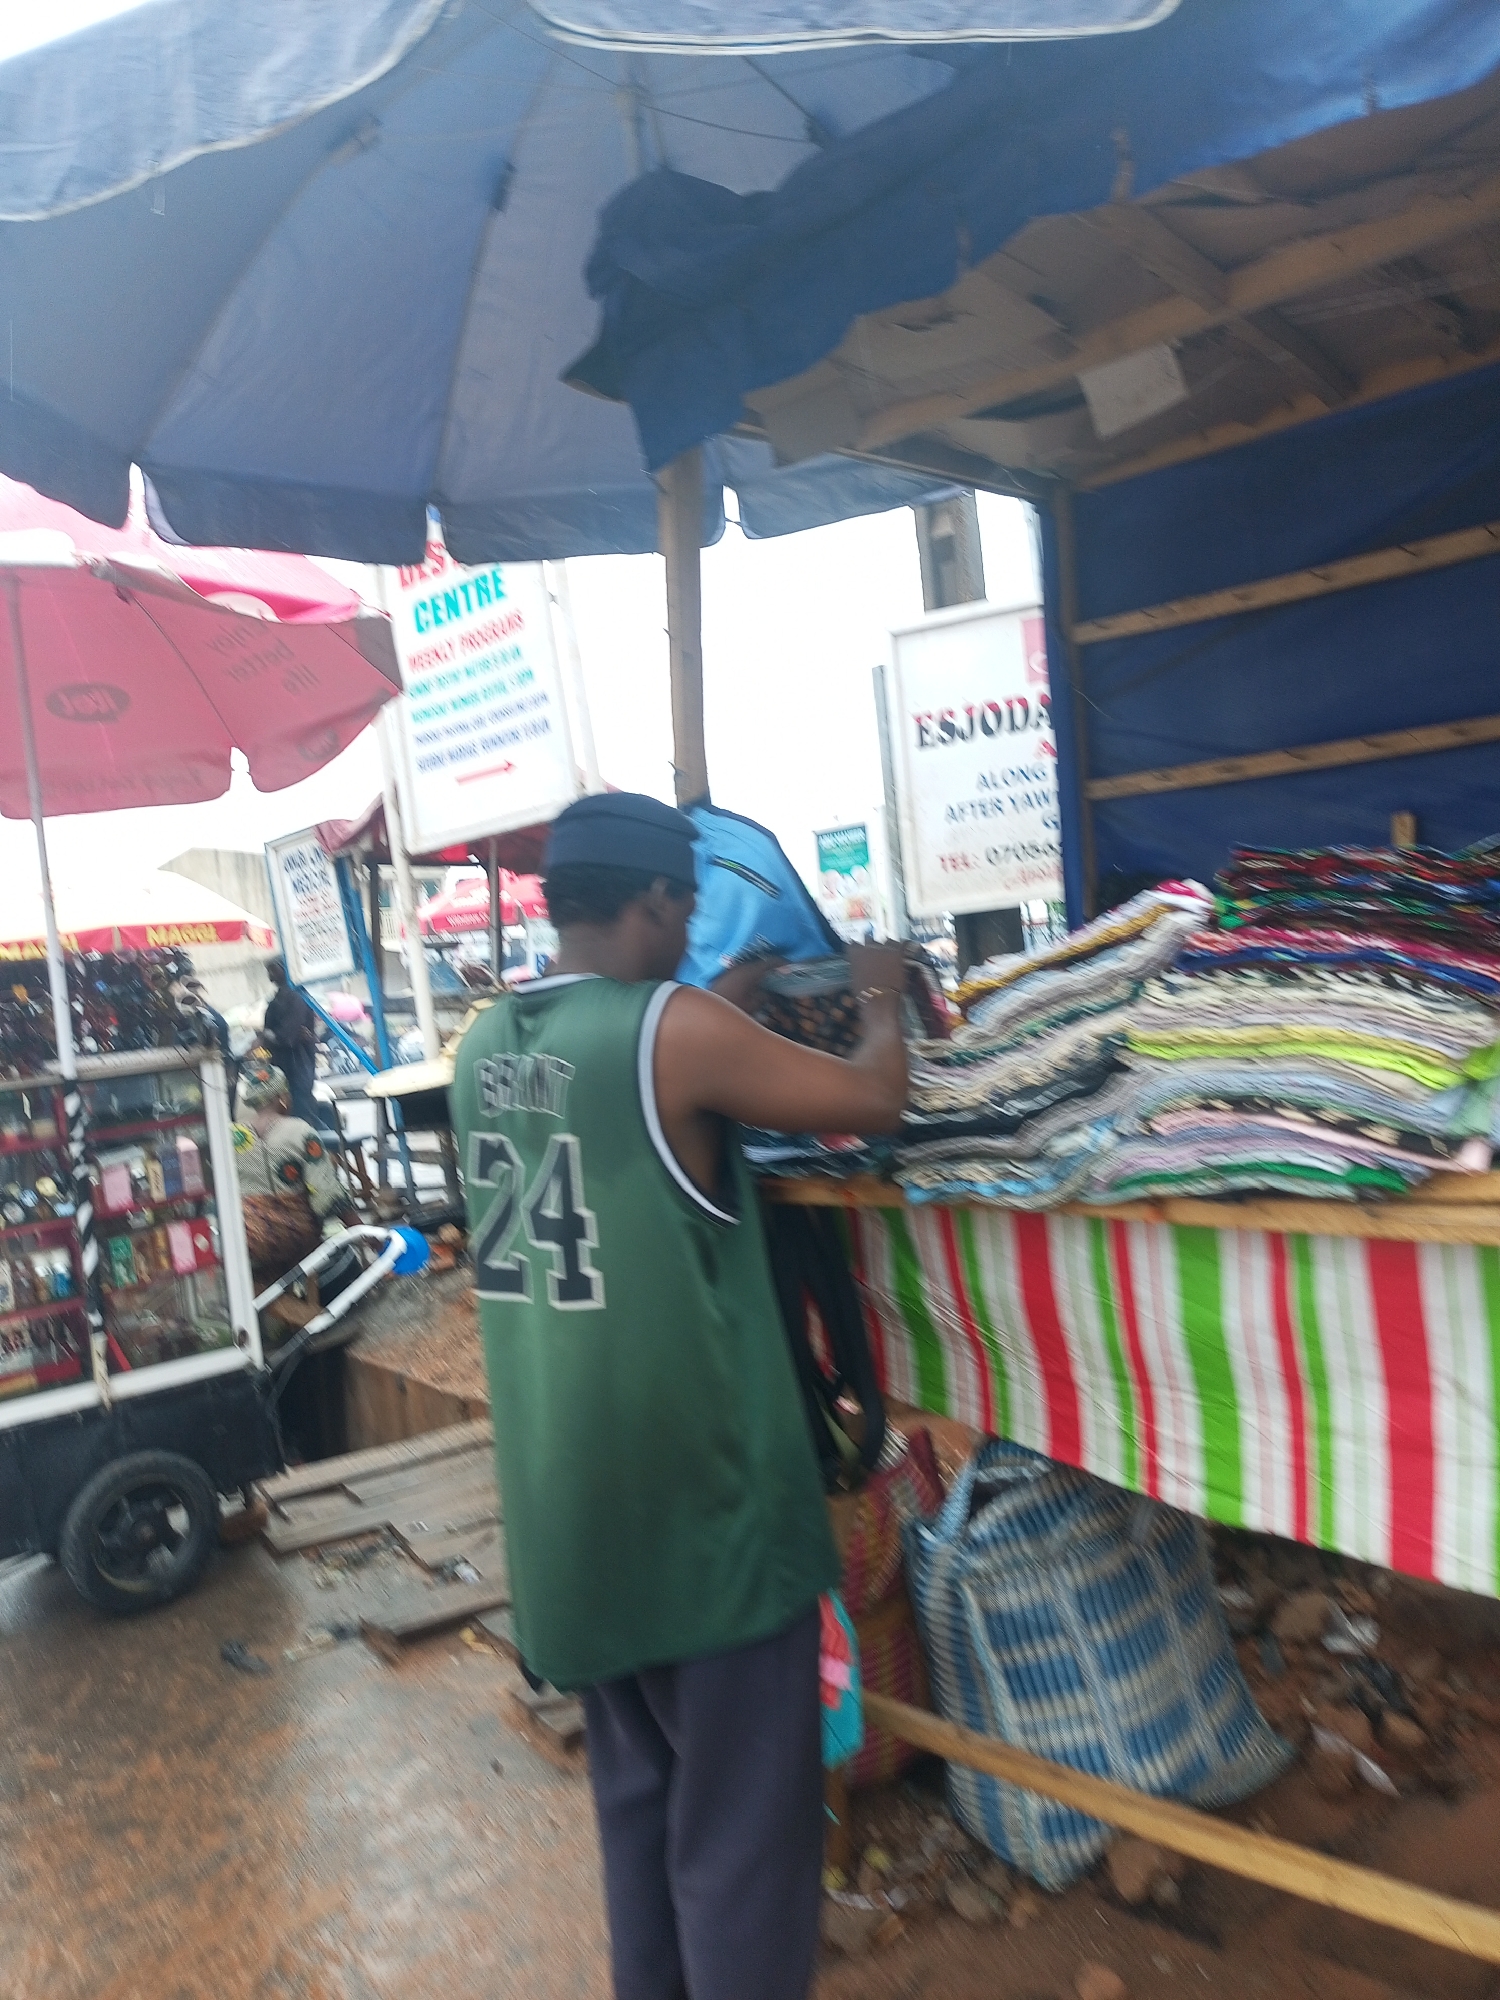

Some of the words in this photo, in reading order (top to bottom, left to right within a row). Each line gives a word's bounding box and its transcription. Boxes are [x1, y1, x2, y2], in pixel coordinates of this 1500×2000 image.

[412, 564, 508, 636] CENTRE
[976, 761, 1047, 793] ALONG
[467, 1130, 607, 1311] 24
